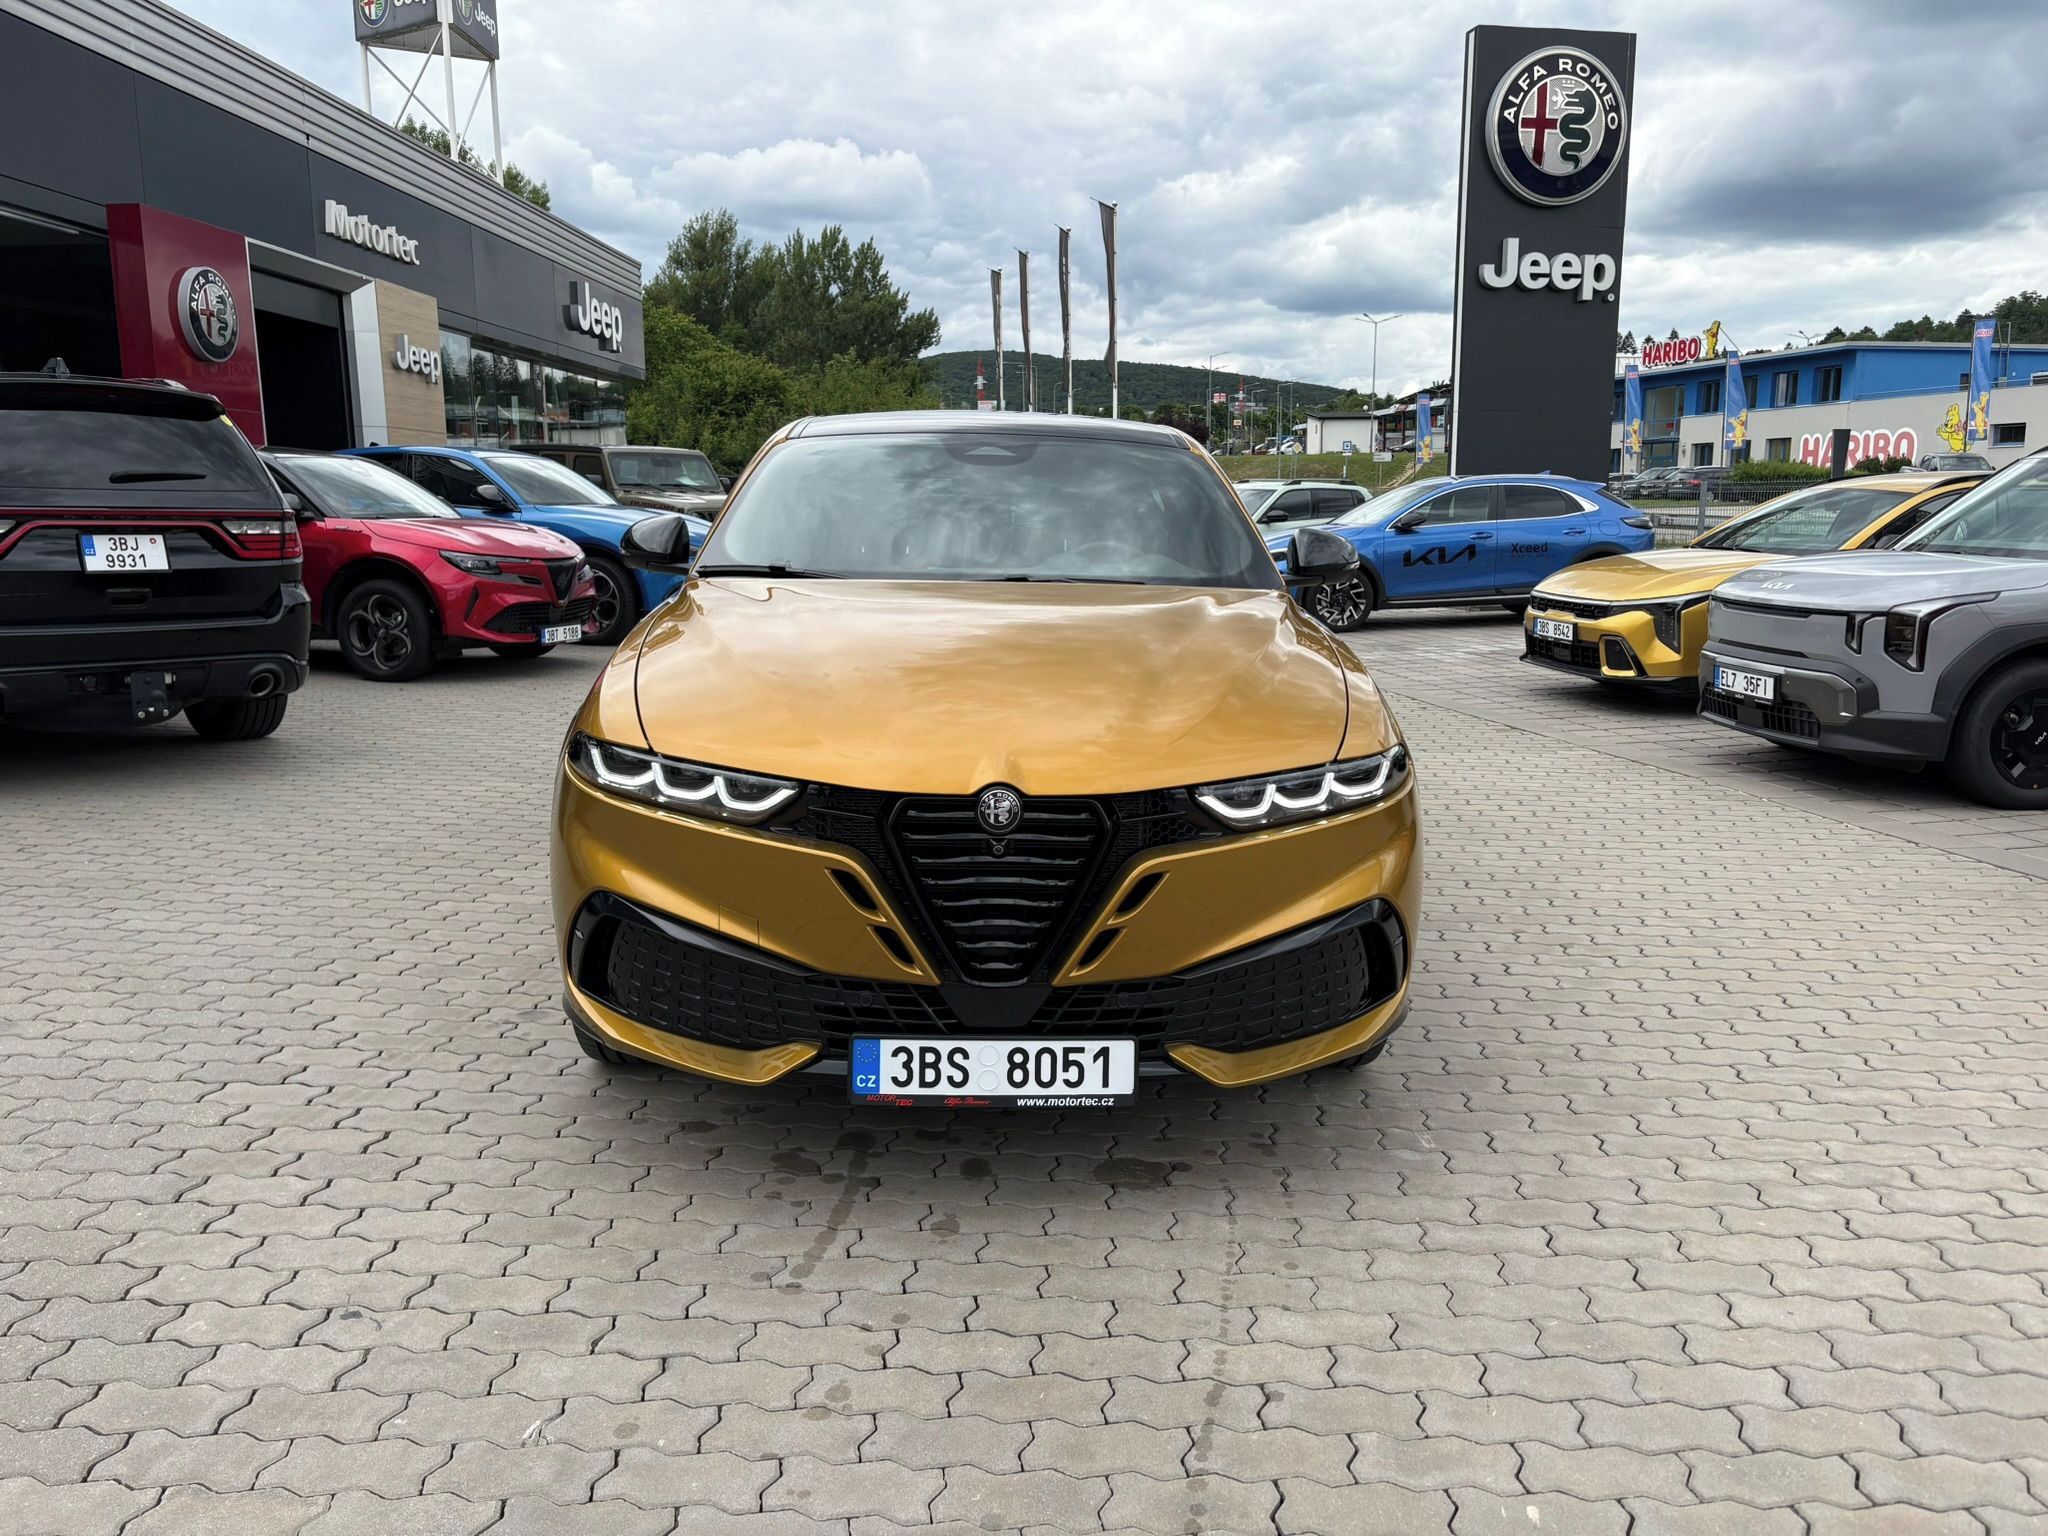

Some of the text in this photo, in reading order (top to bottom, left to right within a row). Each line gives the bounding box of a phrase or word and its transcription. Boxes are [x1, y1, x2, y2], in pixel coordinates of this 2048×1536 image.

[475, 3, 496, 36] Jeep
[1503, 58, 1619, 130] ALFA ROMEO
[325, 199, 420, 266] Motortec
[1479, 237, 1617, 301] Jeep
[191, 277, 206, 312] ALFA
[574, 280, 622, 351] Jeep
[396, 334, 441, 383] Jeep
[1641, 336, 1701, 368] HARIBO
[108, 537, 139, 551] 3BJ
[1511, 541, 1548, 554] Xceed
[106, 554, 147, 568] 9931
[1721, 670, 1736, 689] EL7
[980, 792, 1018, 813] ALFA ROMEO
[856, 1075, 876, 1087] CZ
[890, 1046, 1110, 1088] 3BS 8051
[1017, 1096, 1115, 1106] www.motortec.cz
